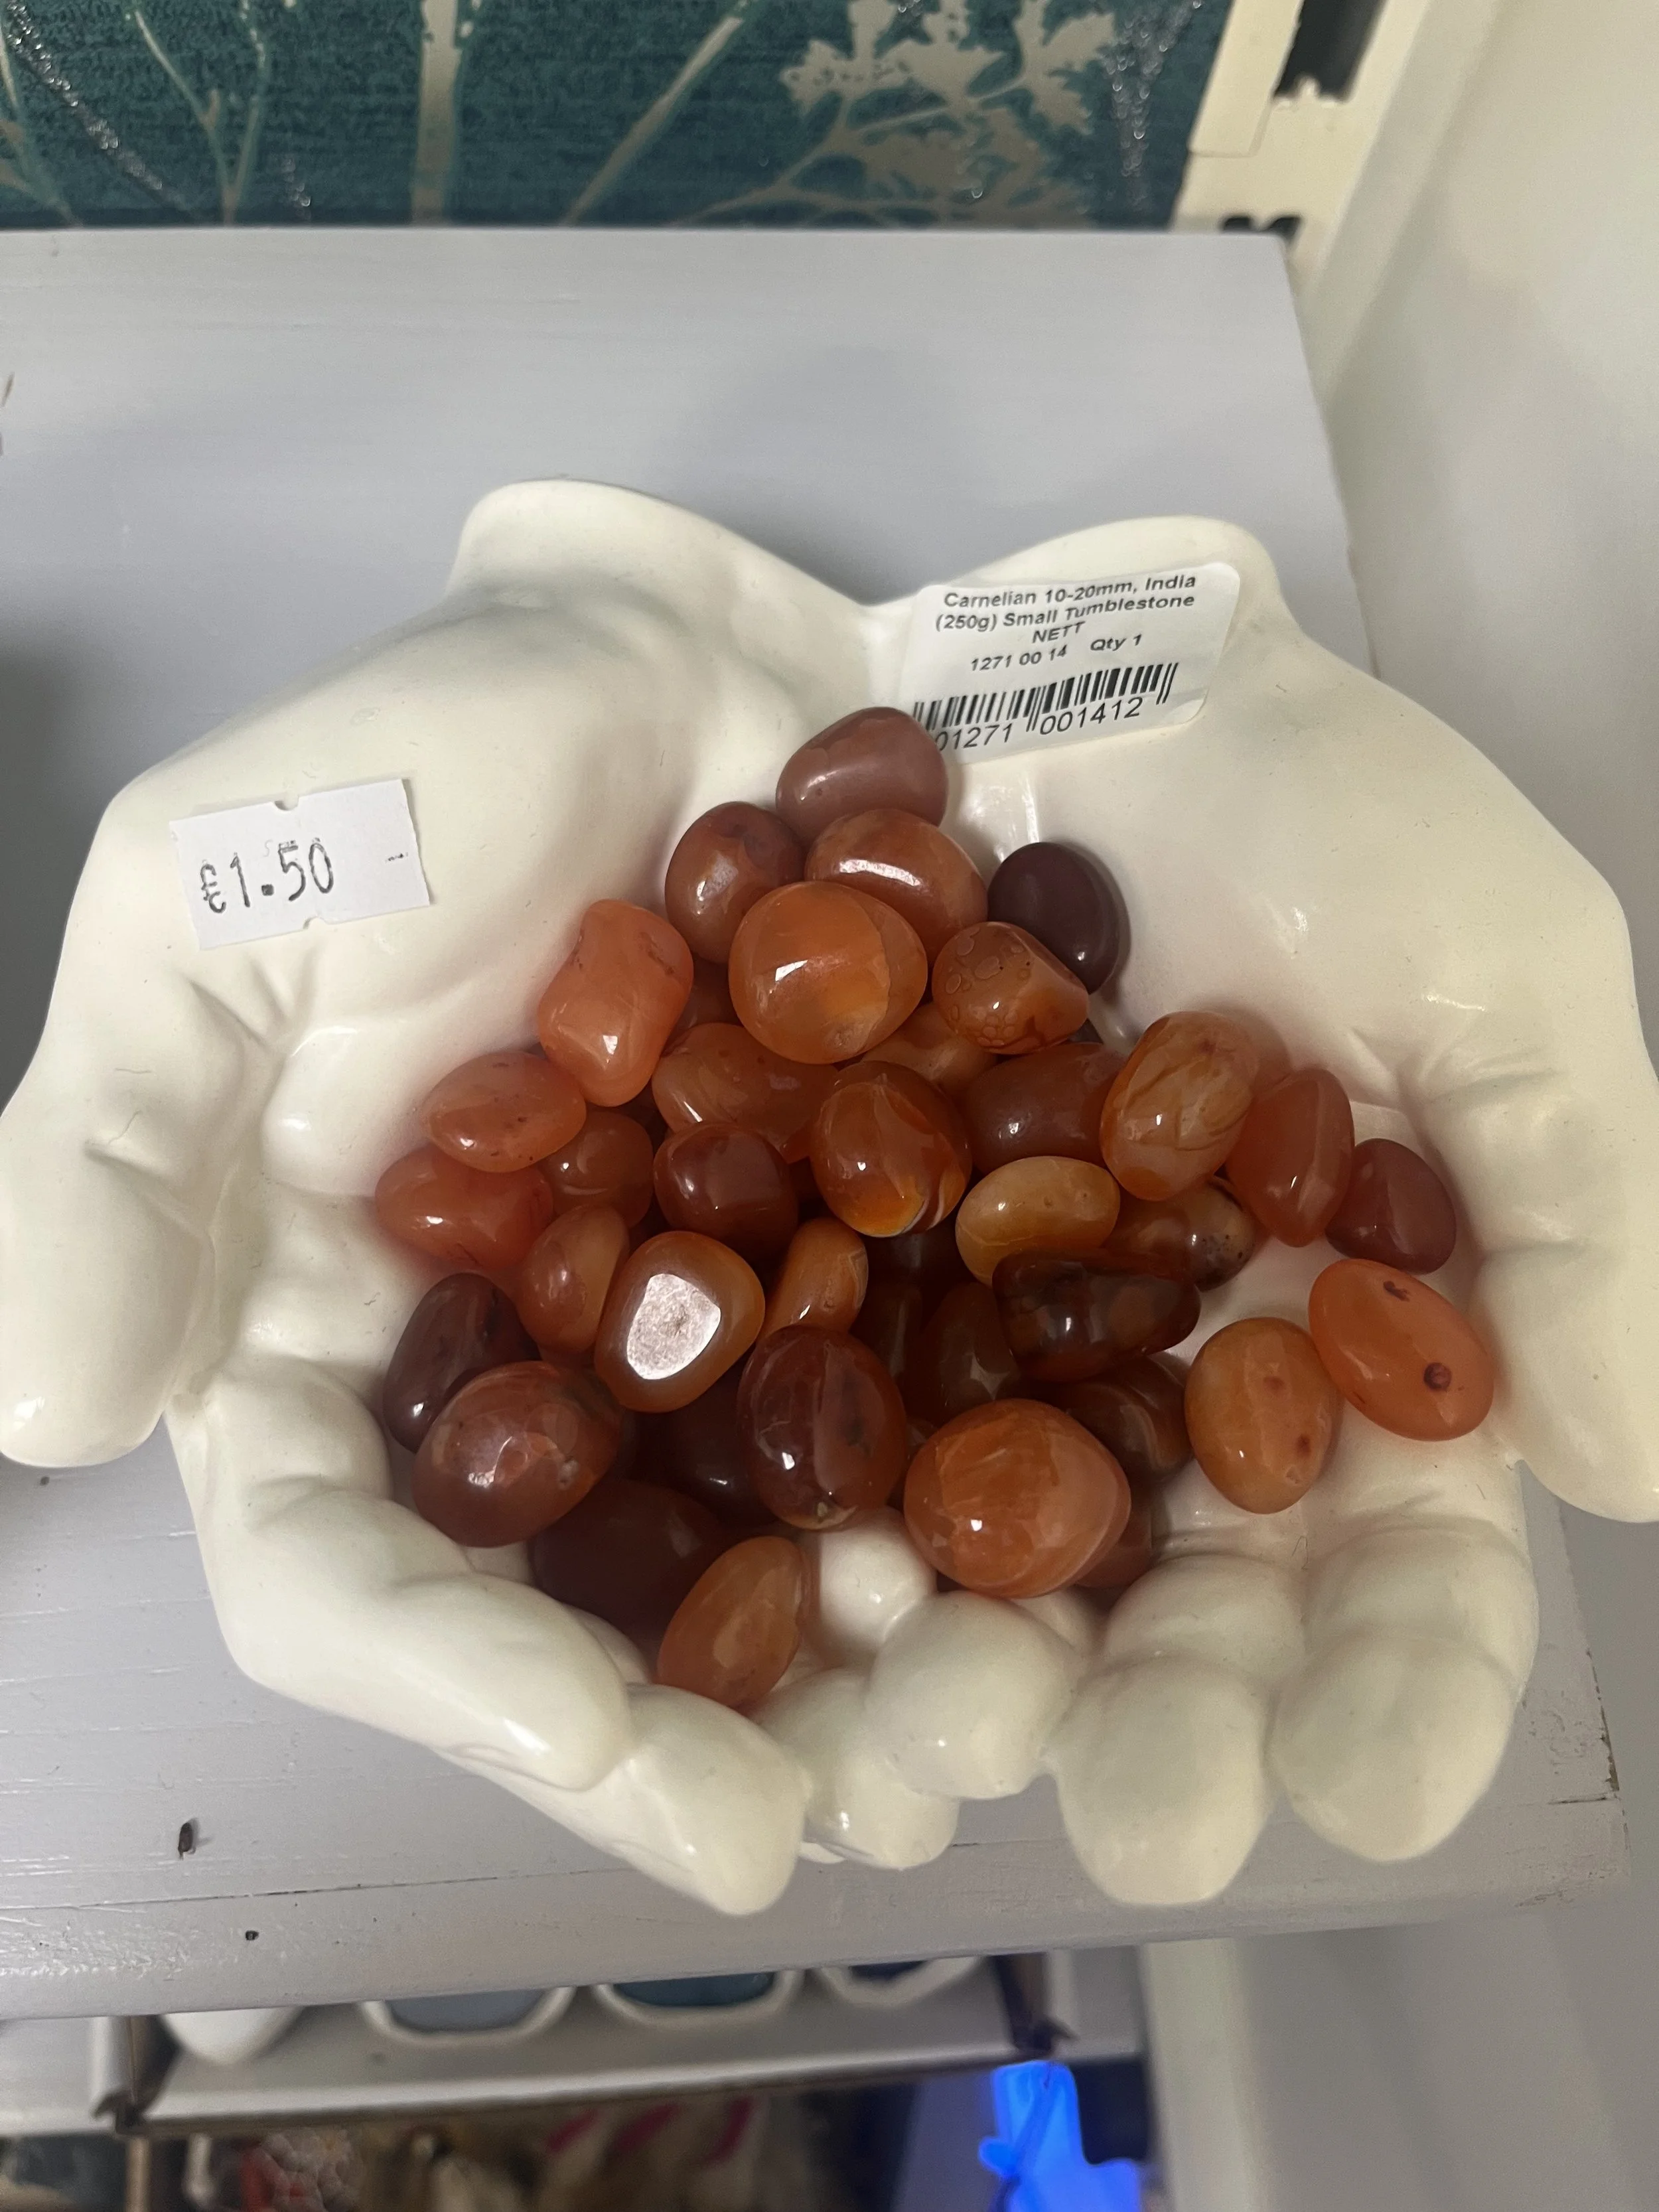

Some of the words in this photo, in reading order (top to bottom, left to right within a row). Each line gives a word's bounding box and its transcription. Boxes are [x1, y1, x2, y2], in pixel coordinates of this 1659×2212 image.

[944, 590, 1037, 608] Carnelian
[1045, 581, 1137, 603] 10-20mm,
[1145, 575, 1196, 591] India
[936, 613, 997, 632] (250g)
[1003, 609, 1058, 627] Small
[1065, 596, 1195, 621] Tumblestone
[1032, 620, 1086, 644] NETT
[971, 654, 1013, 672] 1271
[1019, 651, 1043, 666] 00
[1049, 644, 1068, 662] 14
[1090, 636, 1127, 652] Qty
[1133, 633, 1143, 647] 1
[1040, 697, 1145, 735] 001412
